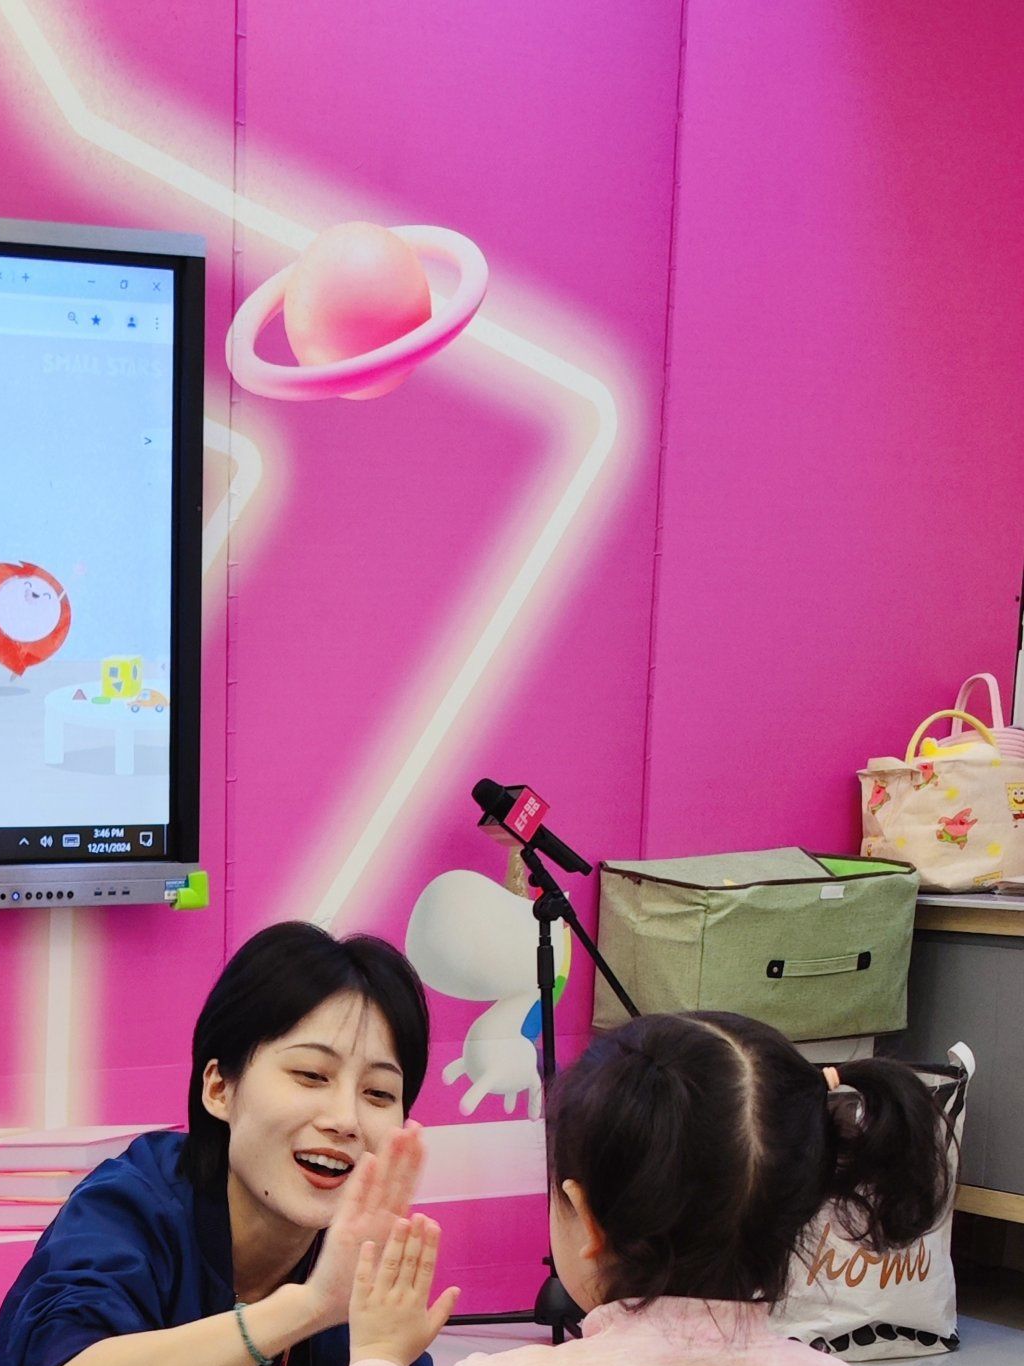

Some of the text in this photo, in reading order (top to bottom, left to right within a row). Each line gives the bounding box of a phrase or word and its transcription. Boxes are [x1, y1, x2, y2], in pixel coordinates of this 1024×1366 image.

[93, 827, 124, 839] 3:46 PM
[87, 842, 131, 854] 12/21/2024
[807, 1222, 931, 1290] home
